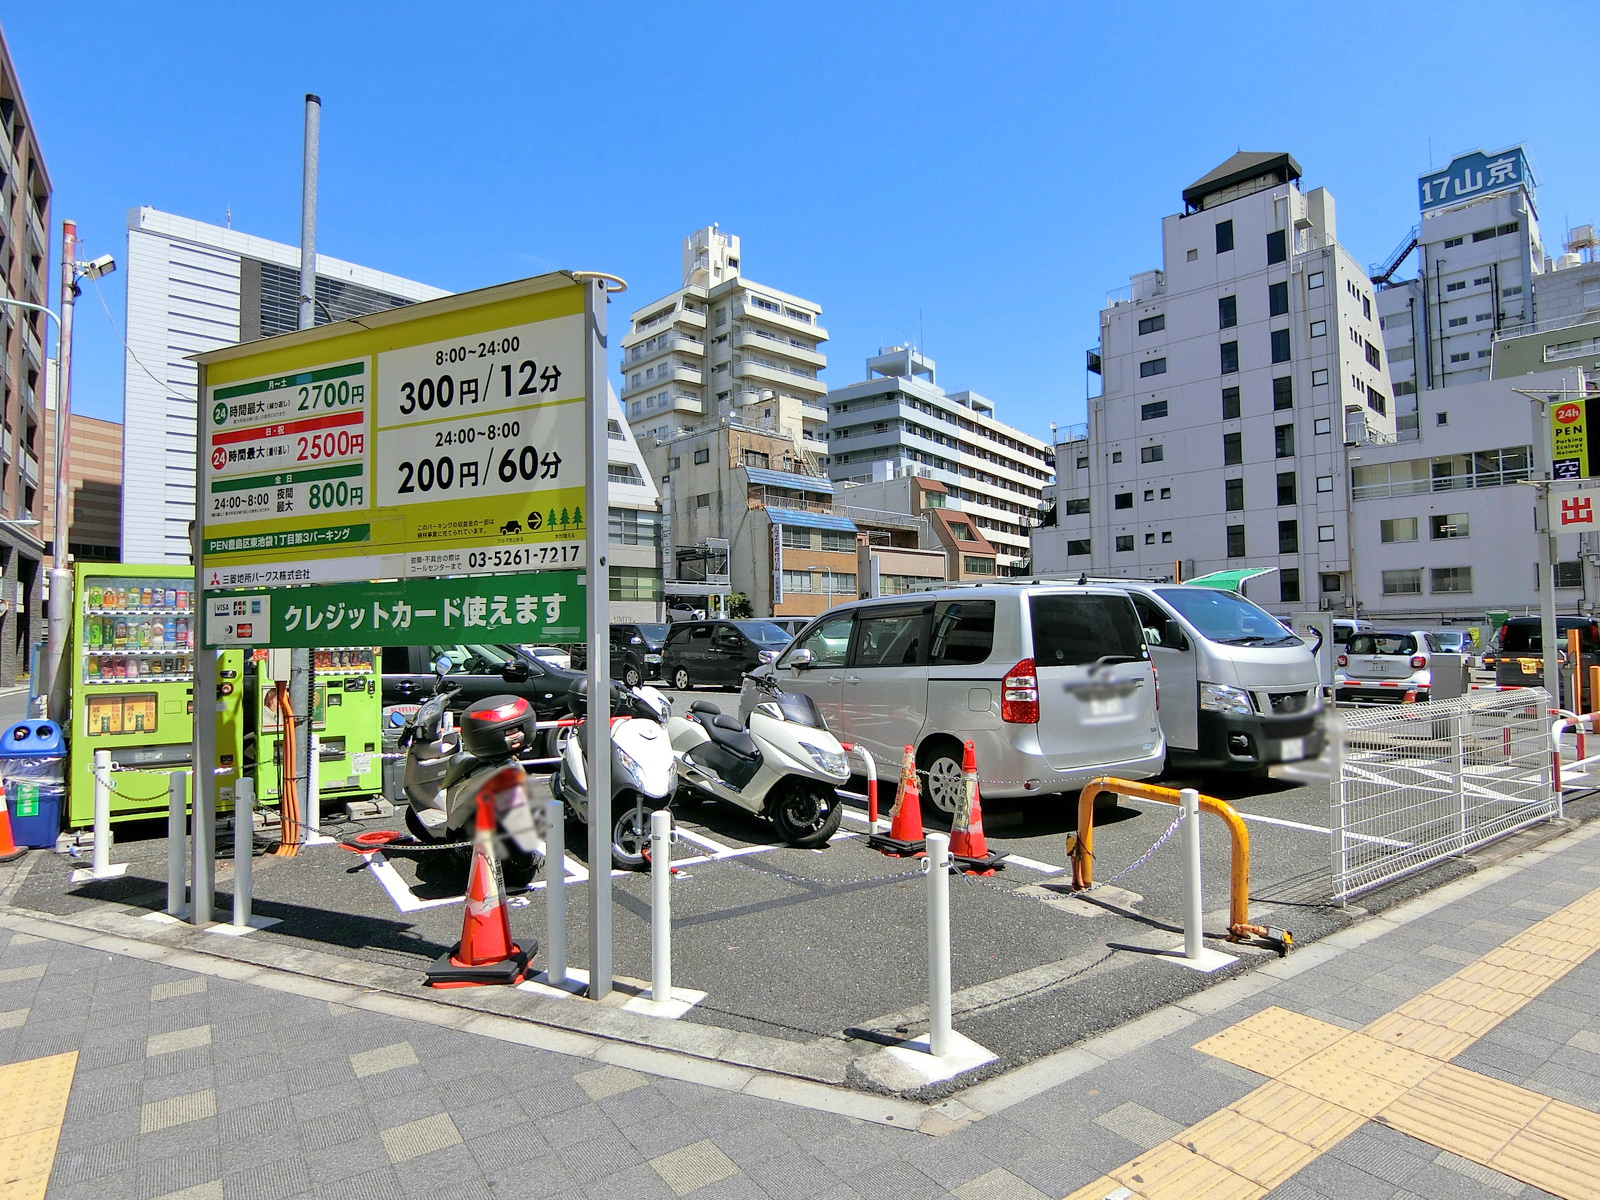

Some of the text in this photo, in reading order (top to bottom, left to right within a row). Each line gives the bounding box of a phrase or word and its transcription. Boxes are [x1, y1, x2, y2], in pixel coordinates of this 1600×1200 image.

[1422, 156, 1518, 204] 17山京
[435, 336, 520, 366] 8:00~24:00
[297, 380, 365, 411] 2700円
[1557, 408, 1579, 420] 24h
[435, 421, 520, 447] 24:00~8:00
[1555, 424, 1583, 437] PEN
[296, 430, 364, 461] 2500円
[214, 492, 270, 510] 24:00~8:00
[309, 481, 363, 510] 800円
[468, 545, 580, 569] 03-5261-7217
[222, 568, 311, 585] 三菱地所パークス株式会社
[284, 592, 567, 633] クレジットカード使えます
